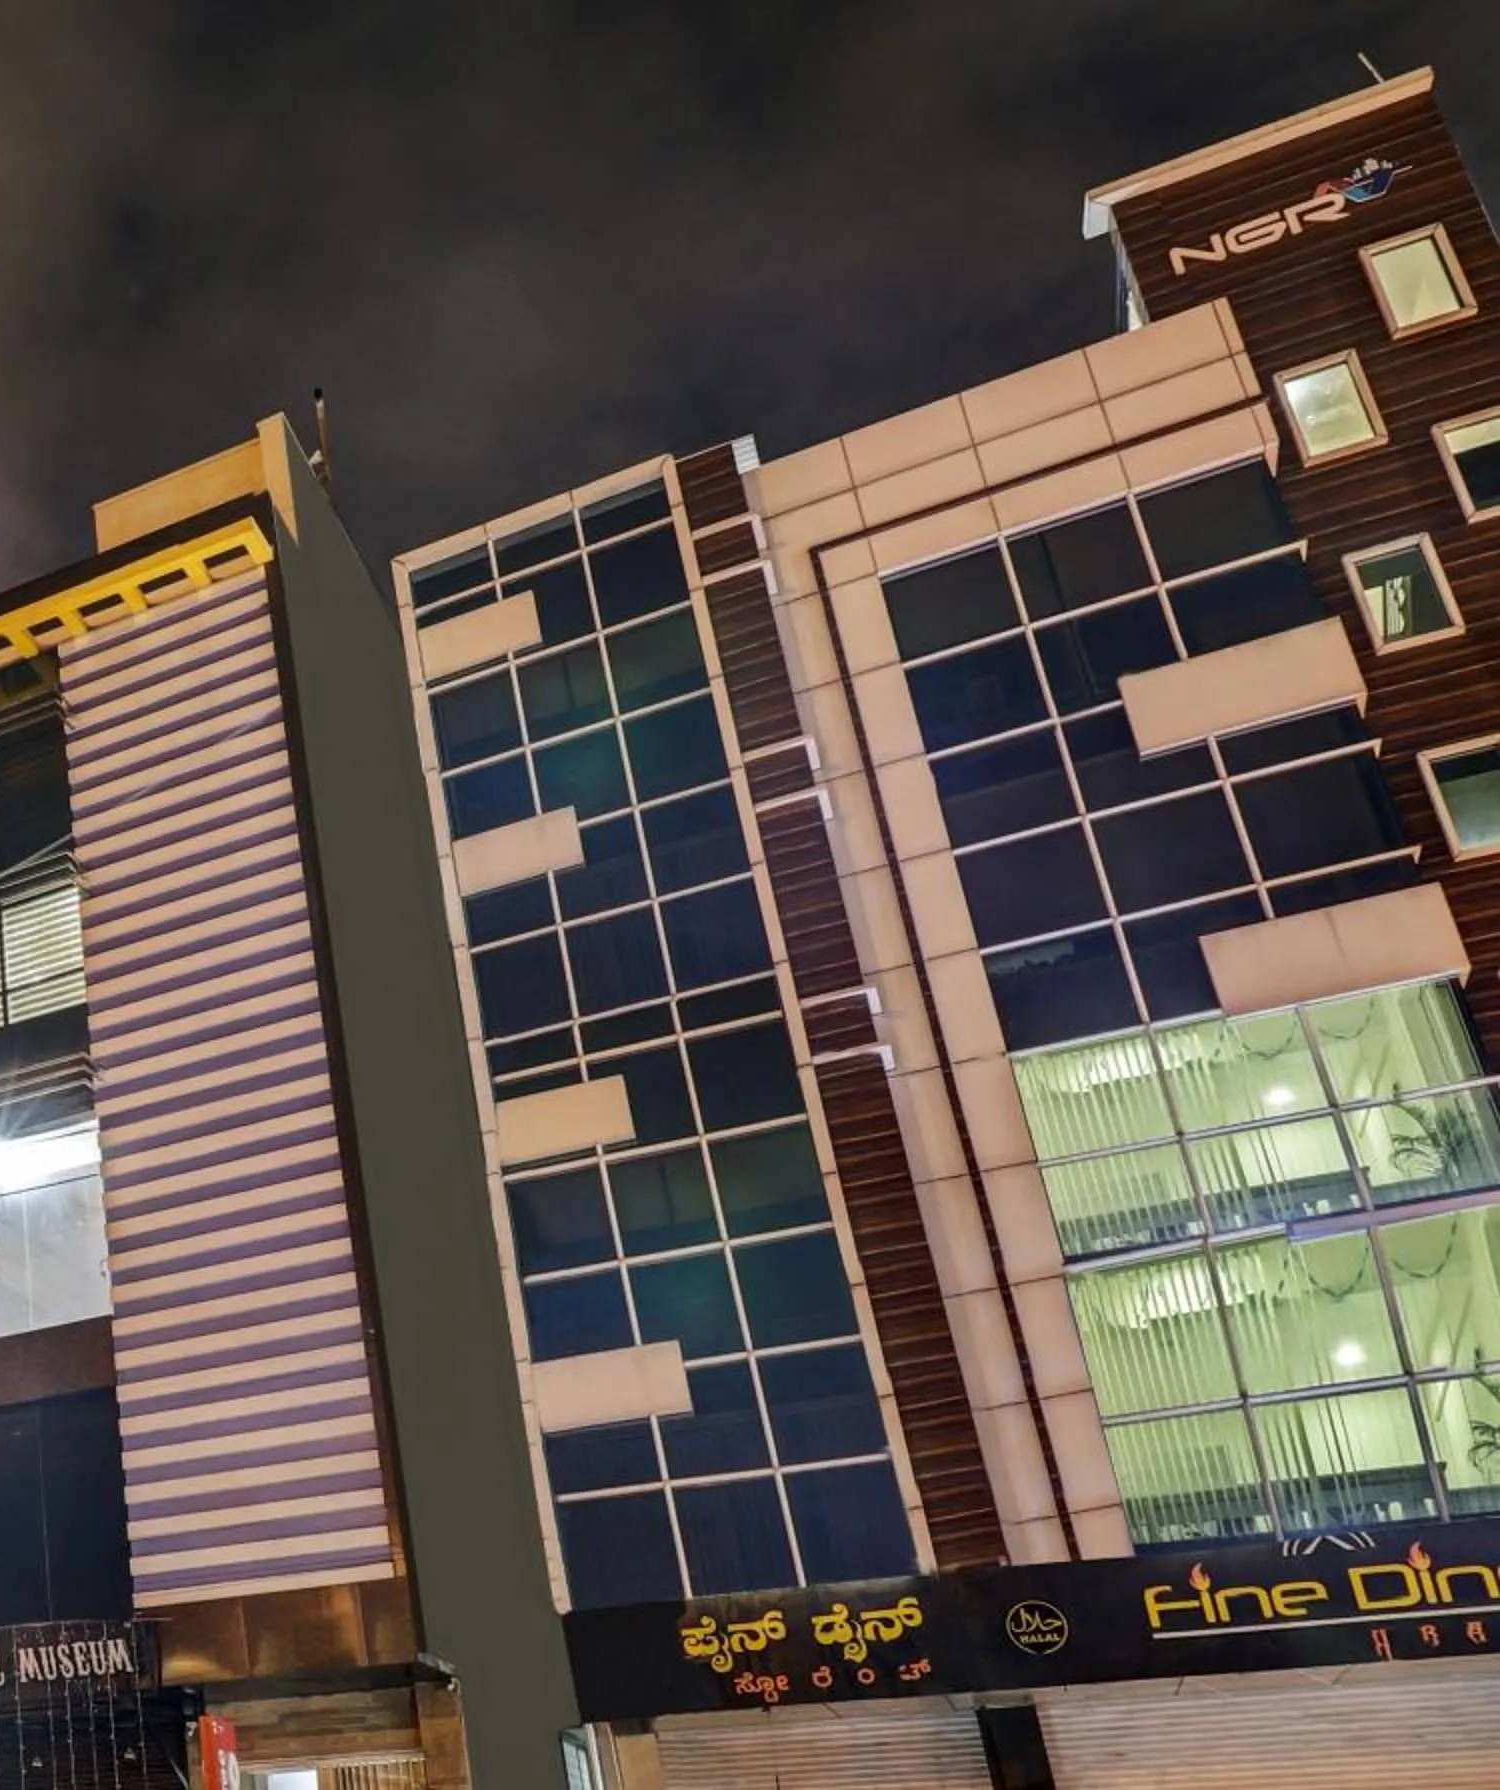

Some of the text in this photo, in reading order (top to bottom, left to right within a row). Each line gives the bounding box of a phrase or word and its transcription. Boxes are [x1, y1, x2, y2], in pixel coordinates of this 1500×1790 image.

[1169, 193, 1349, 276] NGR
[1348, 1541, 1500, 1612] Din
[17, 1638, 135, 1683] MUSEUM
[1019, 1632, 1060, 1644] HALAL
